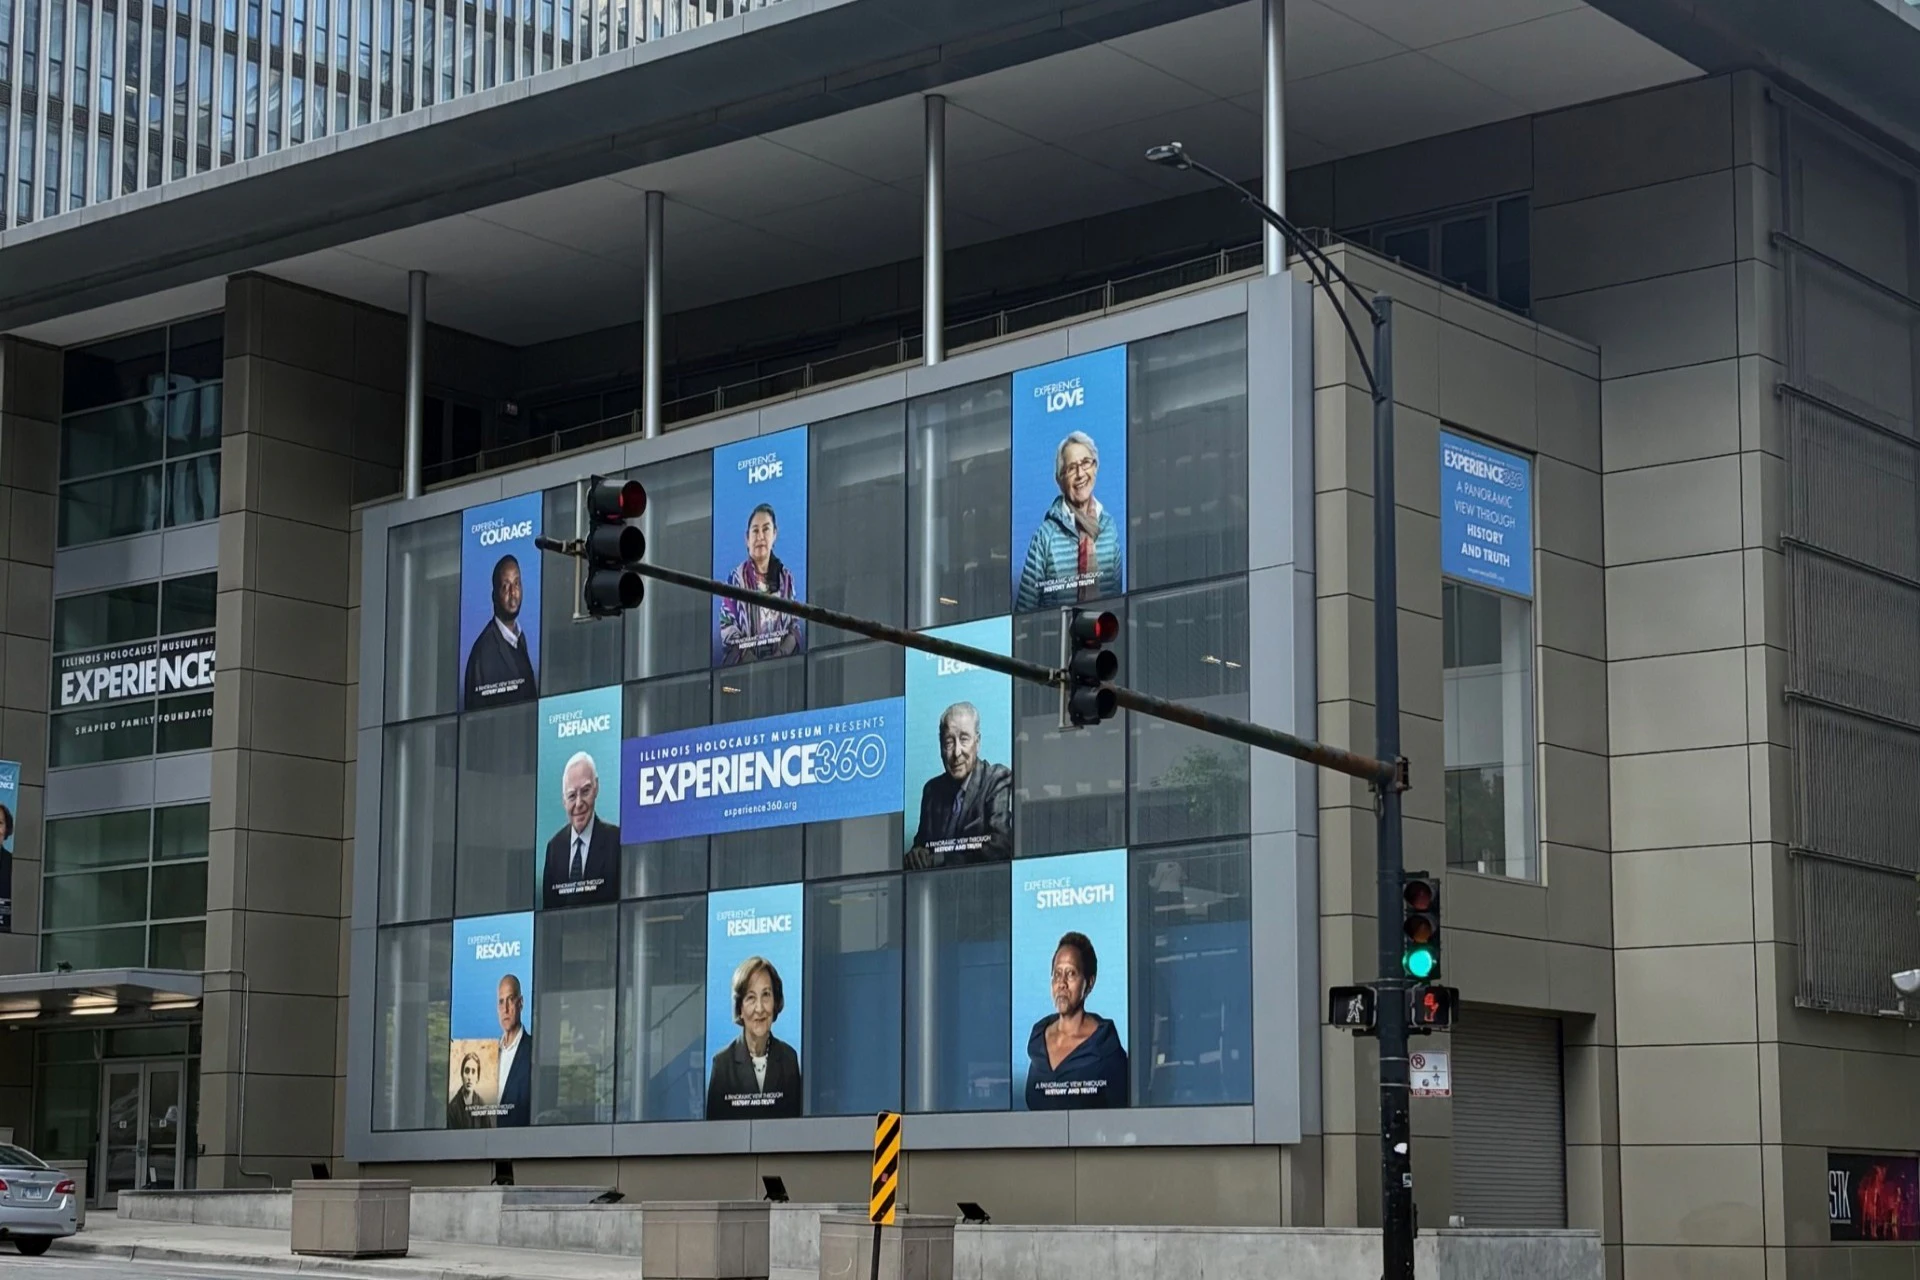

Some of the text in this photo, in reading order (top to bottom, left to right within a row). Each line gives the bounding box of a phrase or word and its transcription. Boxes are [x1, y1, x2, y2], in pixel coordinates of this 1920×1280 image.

[1034, 377, 1081, 398] EXPERIENCE
[1047, 387, 1084, 413] LOVE
[748, 460, 783, 484] HOPE
[1456, 480, 1513, 509] A PANORAMIC
[1454, 500, 1516, 529] VIEW THROUGH
[480, 519, 532, 546] COURAGE
[1467, 523, 1504, 545] HISTORY
[1461, 542, 1510, 568] AND TRUTH
[62, 653, 101, 667] ILLINOIS
[104, 645, 157, 661] HOLOCAUST
[161, 638, 199, 652] MUSEUM
[75, 708, 213, 736] SHAPIRO FAMILY FOUNDATIO
[558, 714, 611, 738] DEFIANCE
[640, 716, 885, 762] ILLINOIS HOLOCAUST MUSEUM PRESENTS
[724, 799, 797, 817] experience360.org
[1037, 883, 1114, 909] STRENGTH
[727, 914, 792, 937] RESILIENCE
[476, 940, 521, 960] RESOLVE
[1828, 1170, 1851, 1218] STK
